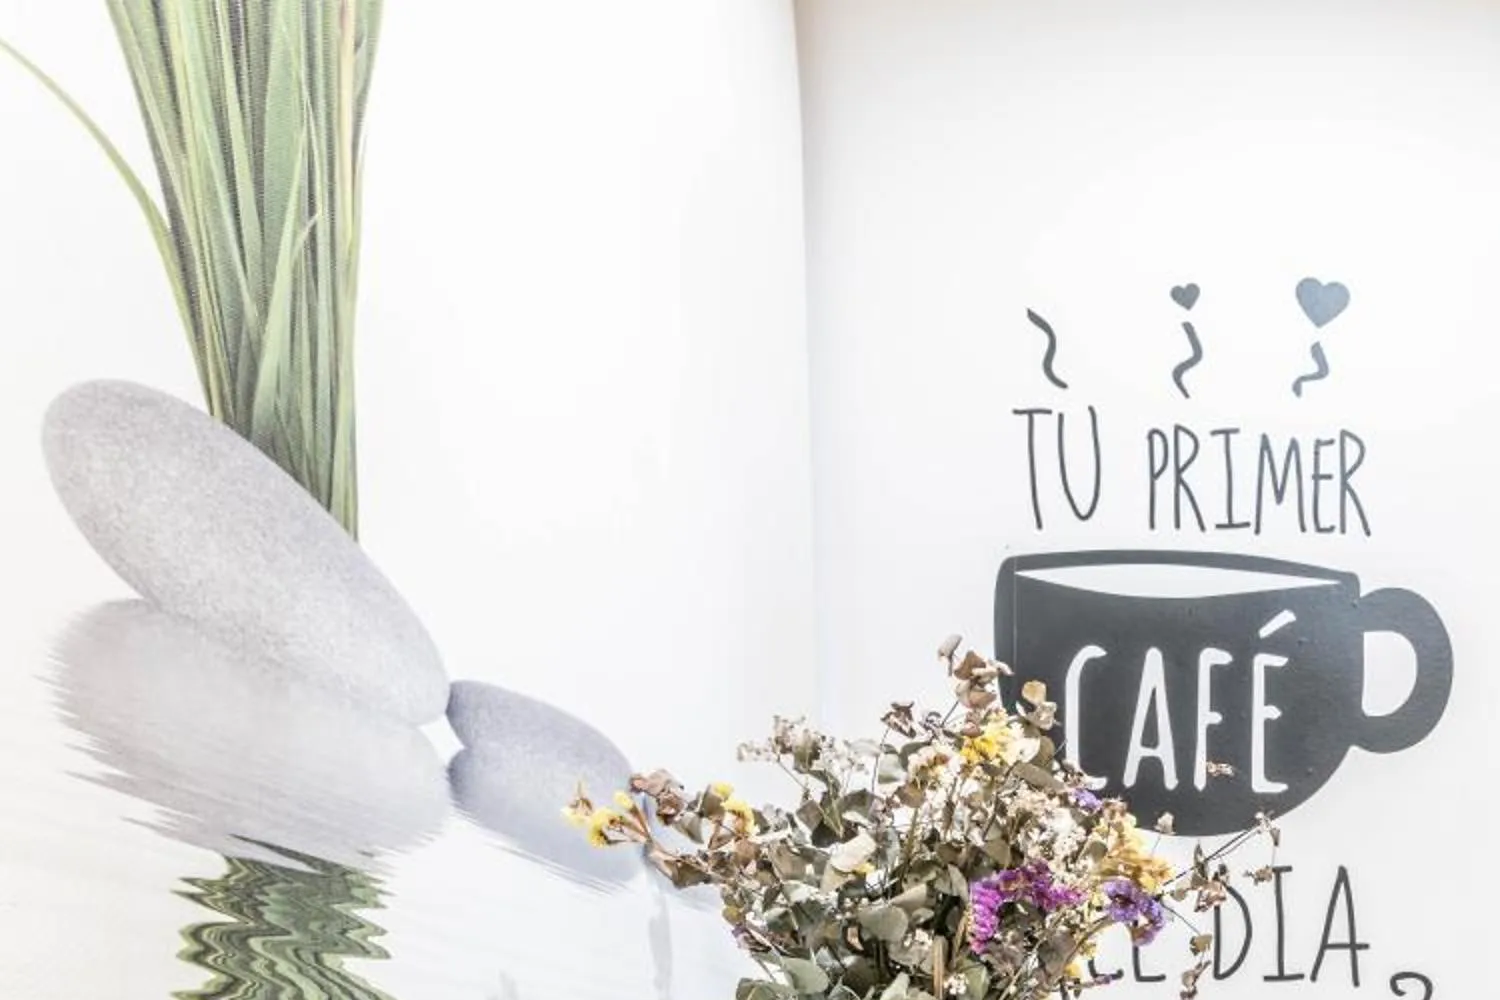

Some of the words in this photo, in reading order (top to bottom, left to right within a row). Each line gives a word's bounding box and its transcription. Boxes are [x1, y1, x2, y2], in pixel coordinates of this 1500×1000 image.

[1013, 405, 1101, 530] TU
[1147, 424, 1371, 536] PRIMER
[1065, 609, 1296, 793] CAFÉ
[1213, 866, 1370, 987] DIA
